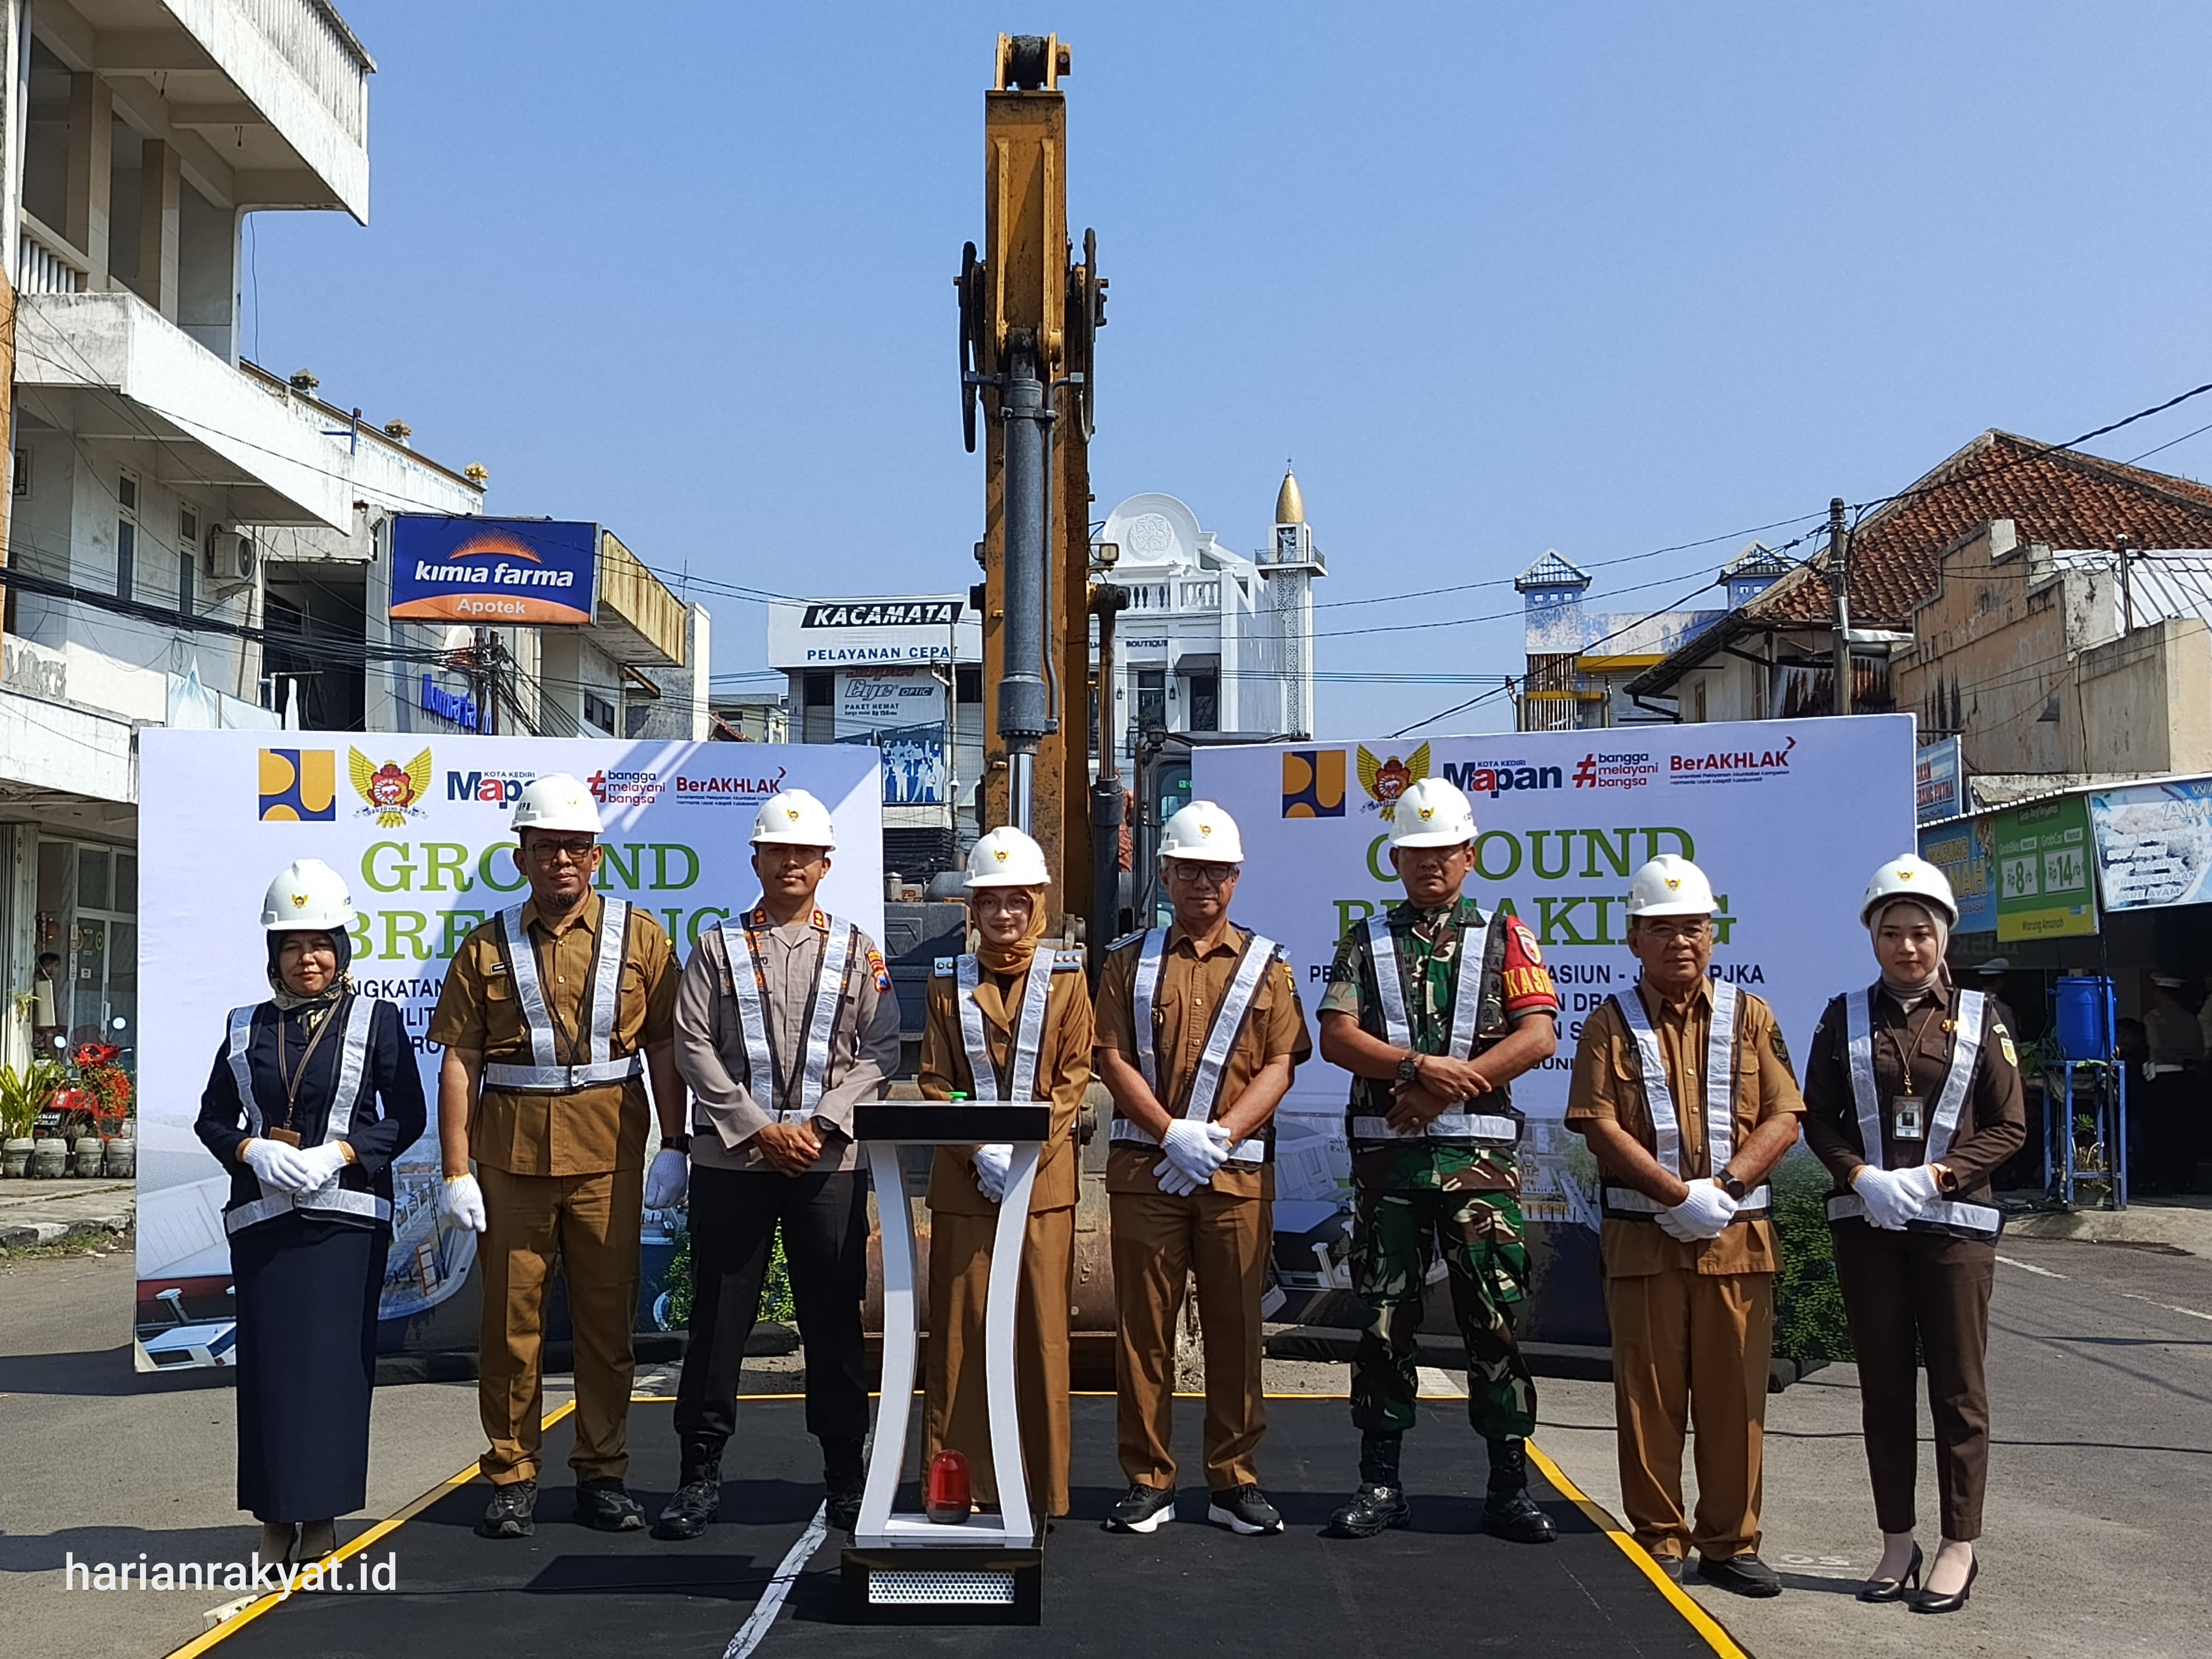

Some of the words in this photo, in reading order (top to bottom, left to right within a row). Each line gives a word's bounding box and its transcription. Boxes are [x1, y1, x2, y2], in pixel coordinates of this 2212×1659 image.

[415, 560, 488, 583] kimia
[494, 562, 574, 587] farma
[457, 598, 526, 615] Apotek
[814, 605, 952, 625] KACAMATA
[807, 648, 900, 660] PELAYANAN
[845, 678, 894, 701] Eye
[1599, 753, 1648, 765] bangga
[1670, 750, 1789, 771] BerAKHLAK
[609, 770, 656, 783] bangga
[1599, 762, 1658, 777] melayani
[609, 782, 665, 794] melayani
[676, 776, 781, 794] BerAKHLAK
[1443, 762, 1562, 798] Mapan
[1599, 777, 1647, 789] bangsa
[447, 771, 537, 809] Map
[609, 793, 655, 807] bangsa
[2164, 797, 2212, 821] AM
[2107, 849, 2132, 860] SOP
[2109, 863, 2134, 873] SOP
[2136, 858, 2181, 871] DAGING
[2112, 870, 2197, 887] KRENGSENGAN
[2147, 886, 2180, 898] AYAM
[1709, 964, 1765, 984] PJKA
